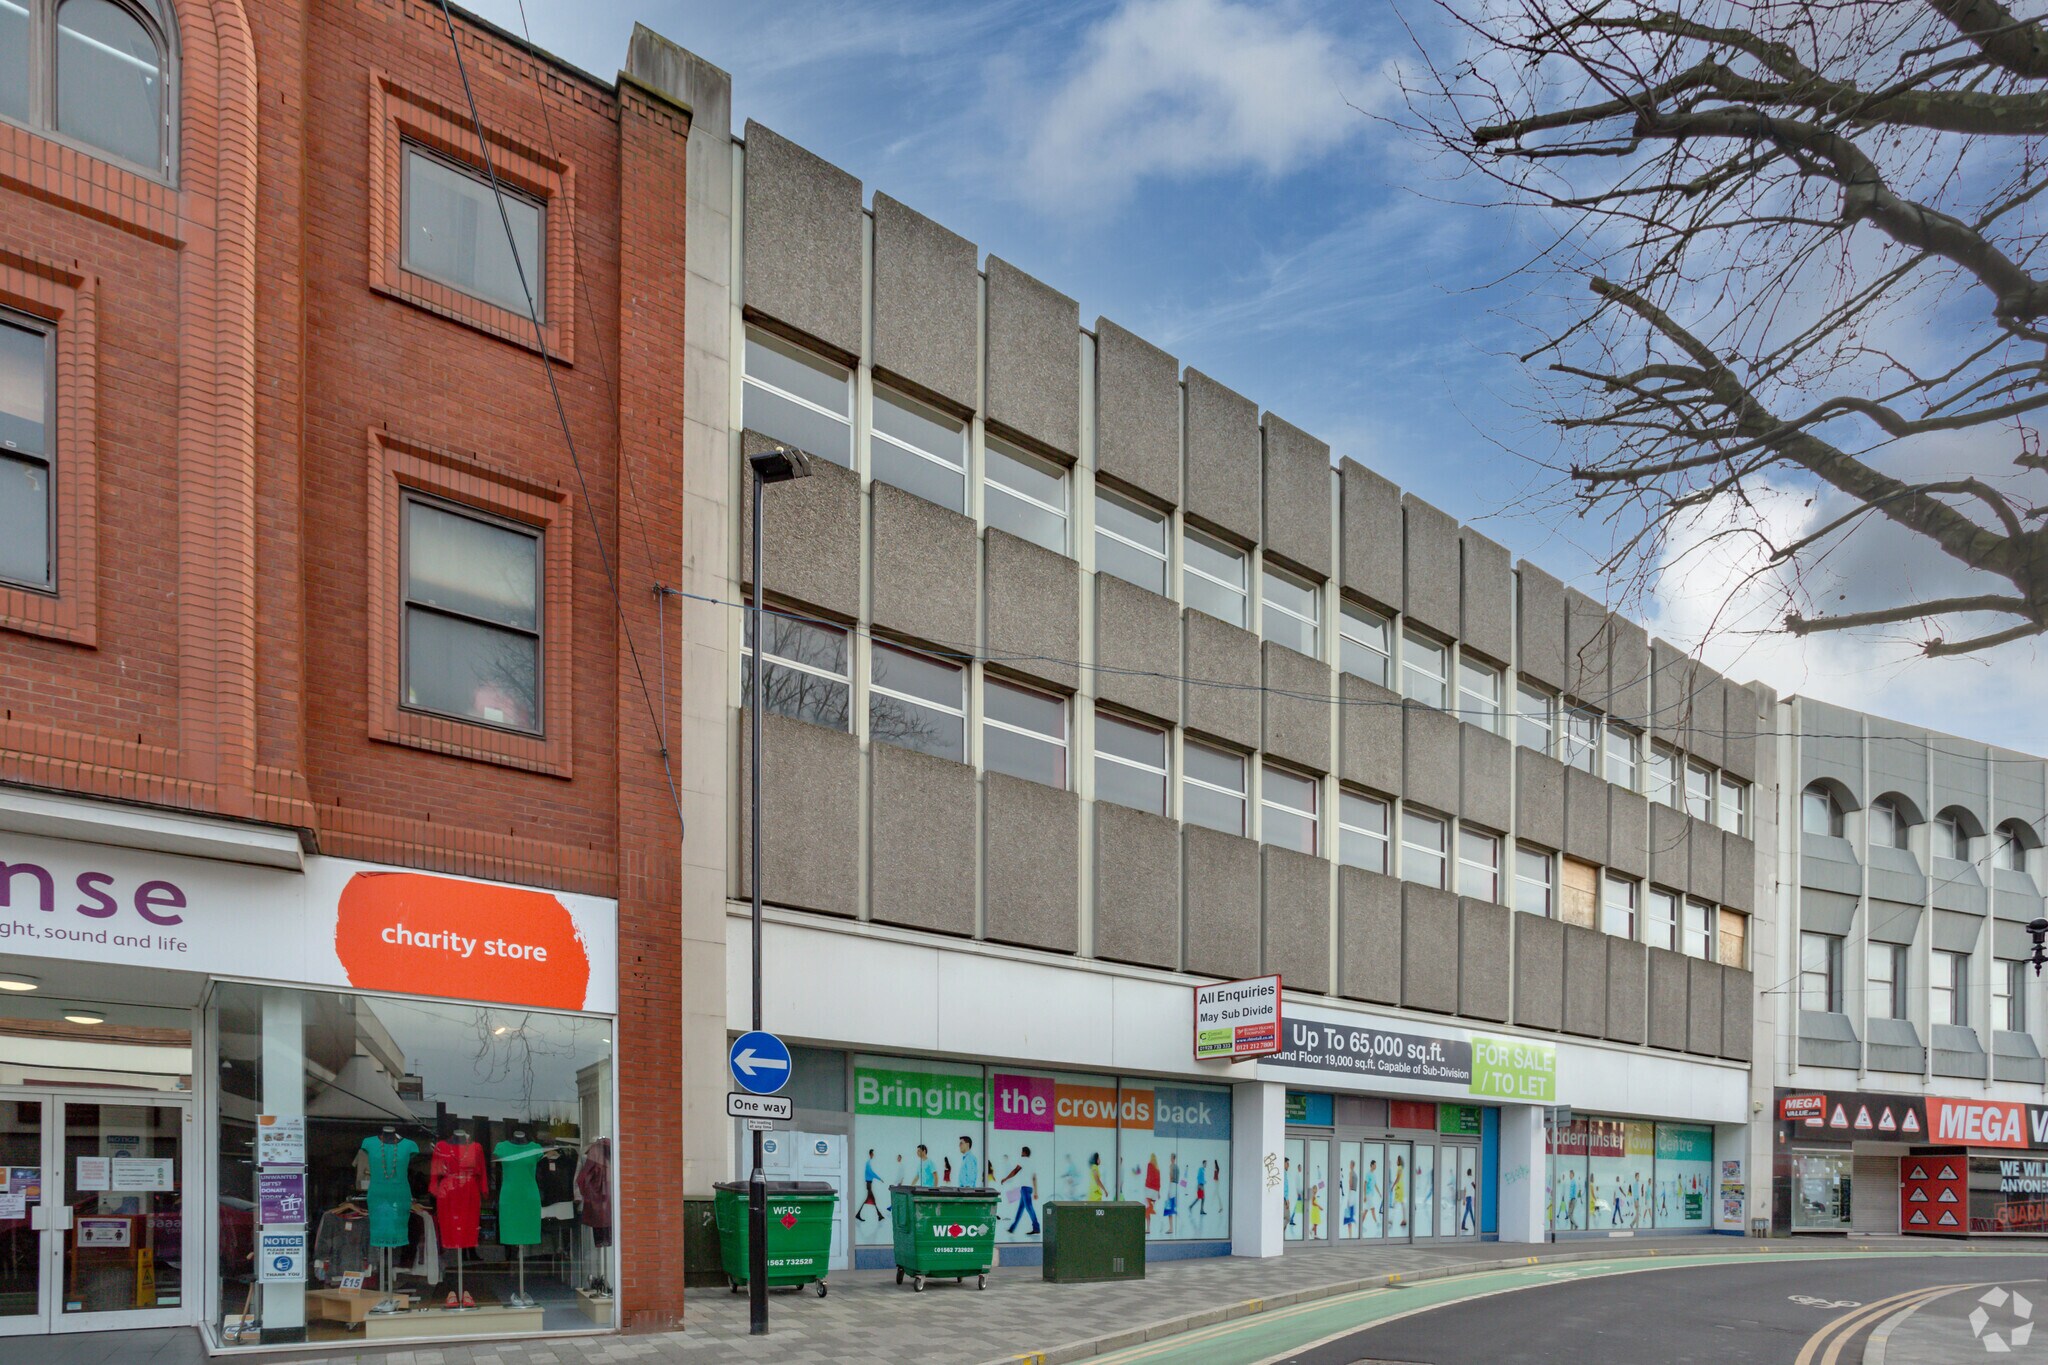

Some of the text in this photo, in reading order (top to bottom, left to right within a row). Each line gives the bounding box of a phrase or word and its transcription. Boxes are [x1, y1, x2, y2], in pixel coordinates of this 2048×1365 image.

[44, 927, 107, 944] sound
[113, 935, 151, 949] and
[158, 936, 188, 953] life
[381, 923, 548, 962] charity store
[1199, 985, 1275, 1005] All Enquiries
[1200, 1005, 1273, 1023] May Sub Divide
[1293, 1024, 1445, 1064] Up To 65,000 sq.ft.
[1299, 1051, 1323, 1063] Floor
[1325, 1054, 1353, 1067] 19,000
[1355, 1059, 1376, 1070] sq.ft.
[1378, 1060, 1411, 1073] Capable
[1413, 1064, 1421, 1074] of
[1422, 1065, 1469, 1079] Sub-Division
[1476, 1043, 1553, 1072] FOR SALE
[1492, 1072, 1515, 1094] TO
[1519, 1074, 1547, 1096] LET
[734, 1099, 787, 1114] One way
[857, 1076, 1212, 1125] Bringing the crowds back
[1785, 1097, 1822, 1109] MEGA
[1939, 1104, 2022, 1142] MEGA
[1627, 1132, 1654, 1150] Town
[1659, 1135, 1693, 1152] Centre
[2000, 1160, 2020, 1176] WE
[264, 1237, 303, 1245] NOTICE
[342, 1277, 361, 1288] £15
